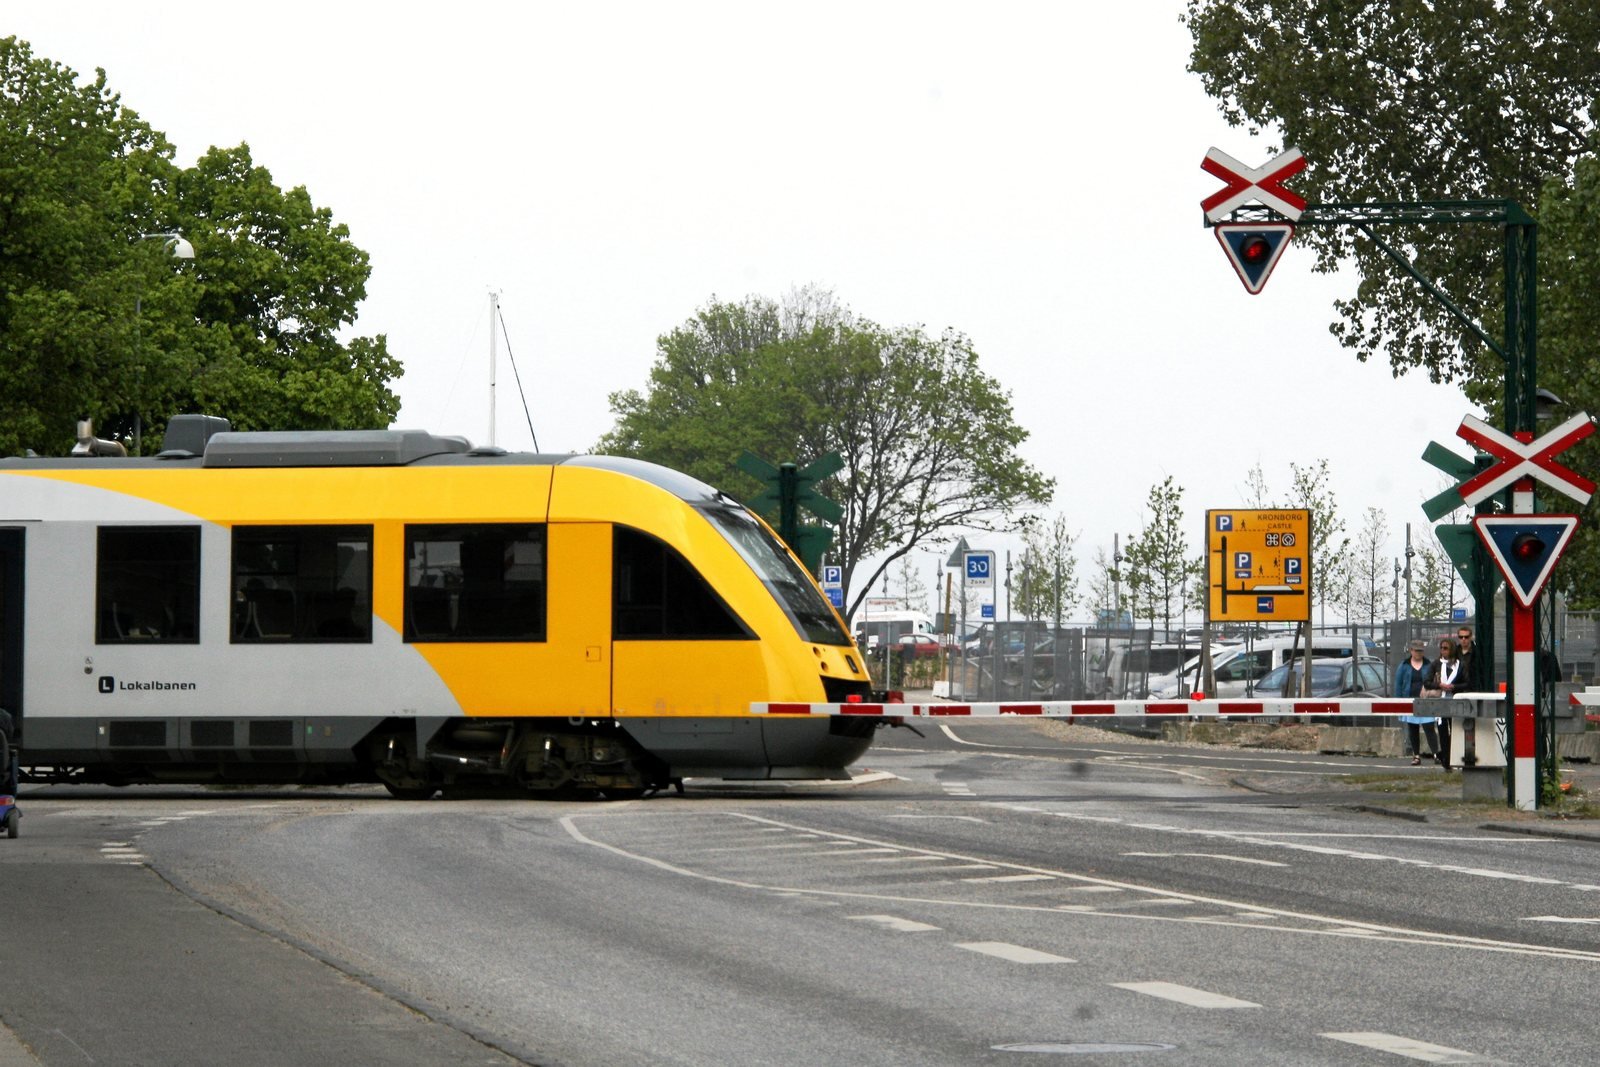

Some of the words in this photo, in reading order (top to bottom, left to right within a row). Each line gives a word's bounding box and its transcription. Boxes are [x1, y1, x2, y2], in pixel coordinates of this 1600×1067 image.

[1219, 516, 1229, 531] P
[1257, 513, 1303, 521] KRONBORG
[969, 560, 988, 573] 30
[1238, 553, 1249, 568] P
[1288, 559, 1299, 574] P
[828, 568, 838, 582] P
[119, 680, 196, 691] Lokalbanen
